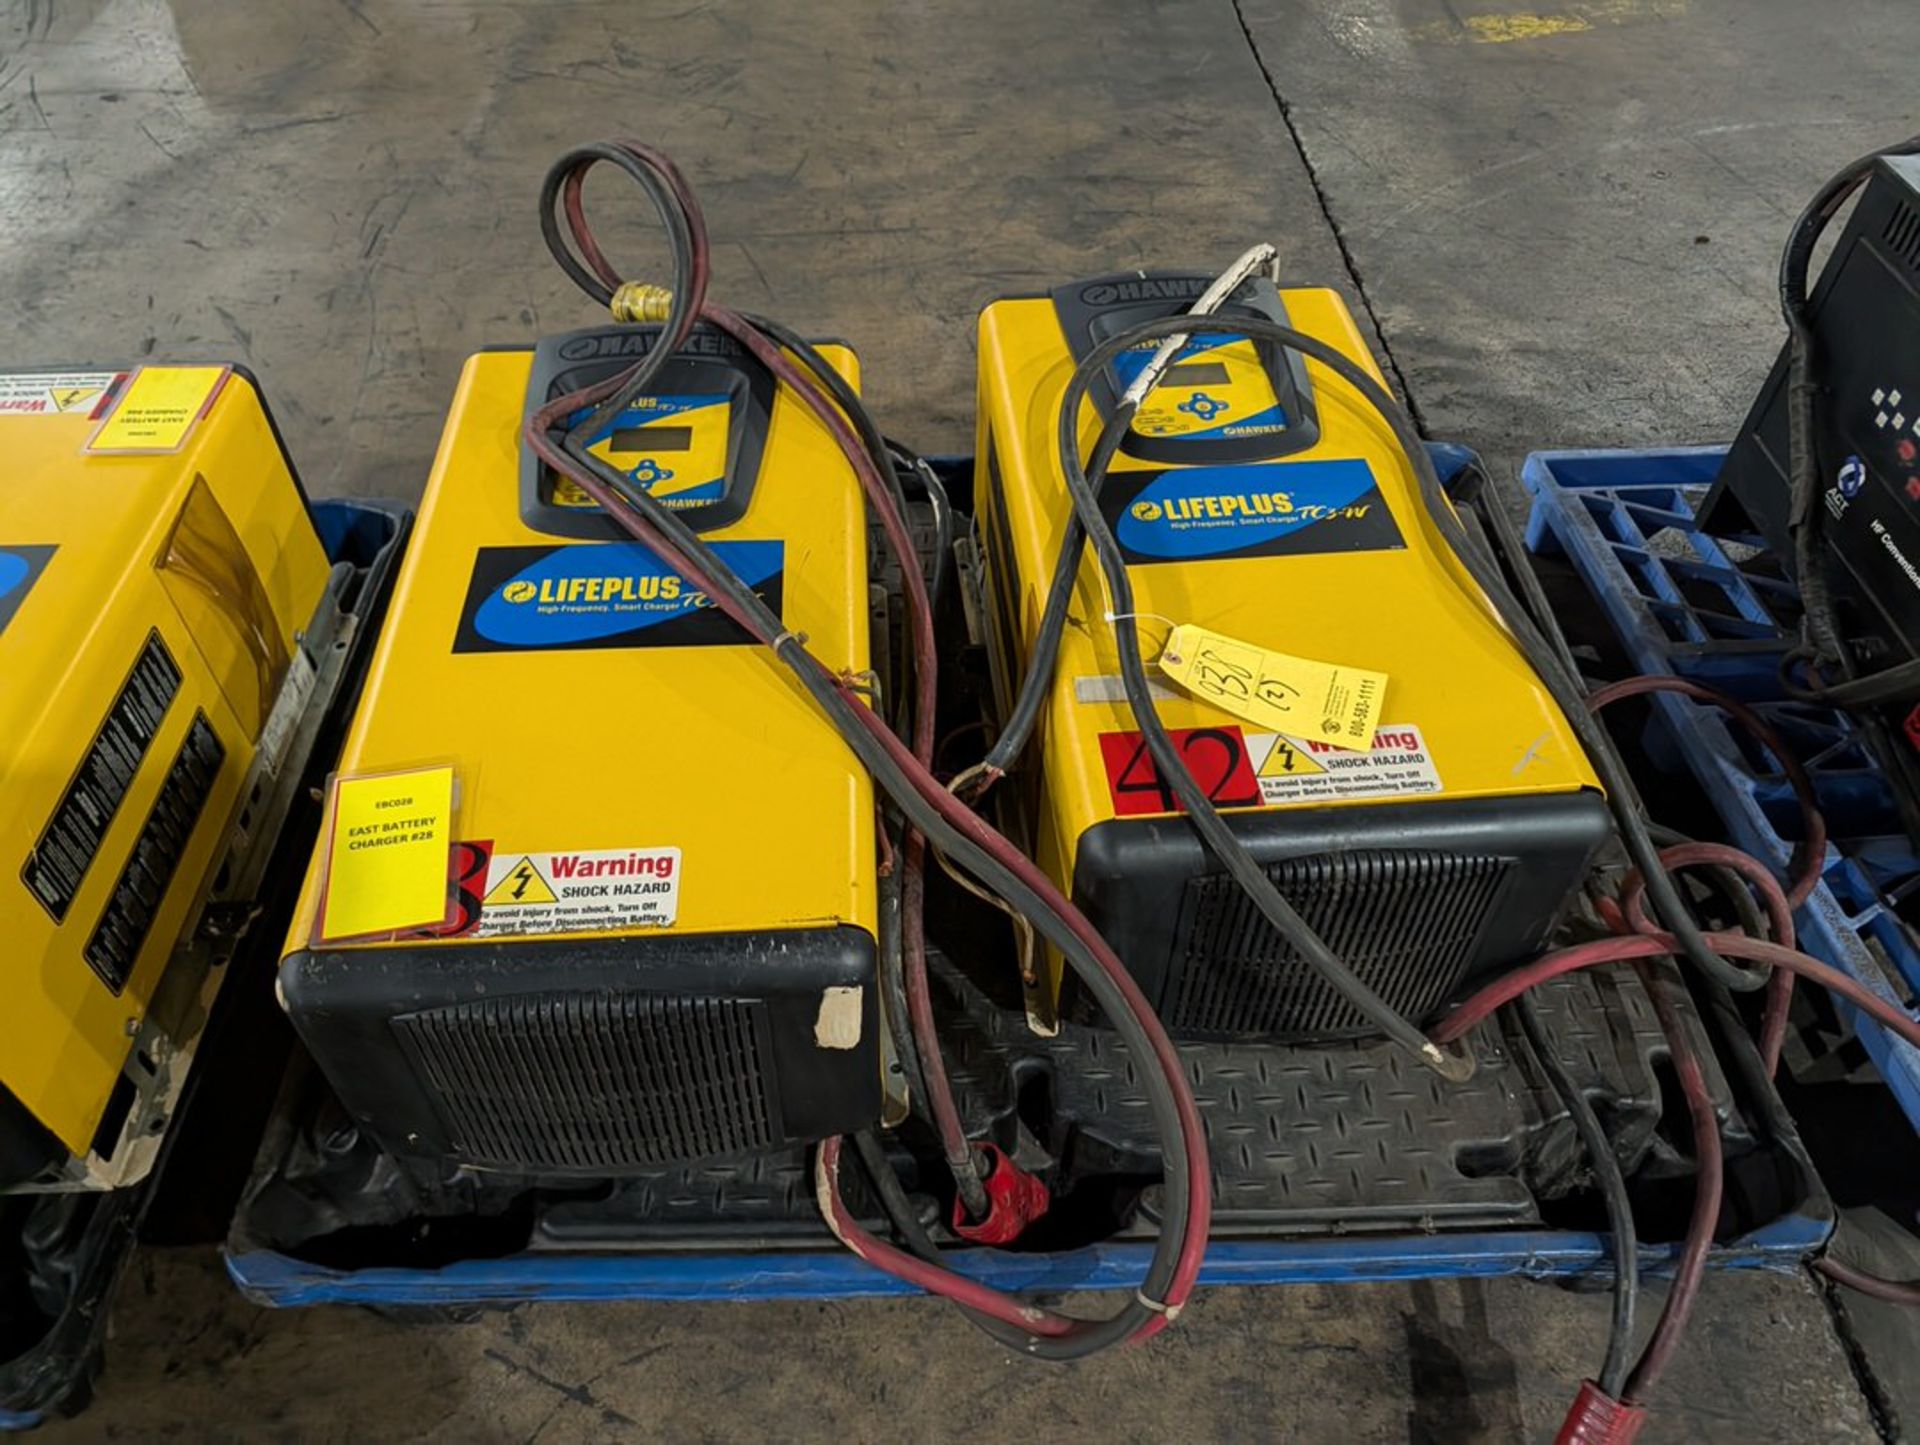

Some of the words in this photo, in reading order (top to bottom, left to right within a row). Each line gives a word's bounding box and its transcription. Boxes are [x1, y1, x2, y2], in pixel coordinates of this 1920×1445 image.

[0, 400, 46, 412] Warn
[1237, 424, 1286, 435] HAWKER
[1163, 492, 1294, 520] LIFEPLUS
[1827, 488, 1849, 511] ACT
[1171, 521, 1189, 530] High
[1240, 517, 1265, 526] Smart
[1266, 515, 1299, 526] Charger
[1870, 519, 1885, 533] HF
[1882, 534, 1920, 588] Convention
[538, 575, 681, 603] LIFEPLUS
[537, 604, 561, 614] High
[614, 602, 642, 612] Smart
[643, 602, 680, 612] Charger
[1306, 729, 1419, 752] Wing
[1328, 756, 1370, 769] SHOCK
[1372, 753, 1425, 766] HAZARD
[1117, 729, 1260, 812] 42
[1275, 779, 1299, 788] avoid
[1384, 772, 1405, 780] Turn
[1264, 790, 1300, 799] Charger
[1303, 788, 1333, 796] Before
[1335, 783, 1400, 793] Disconnecting
[350, 823, 379, 837] EAST
[382, 816, 437, 832] BATTERY
[349, 835, 409, 850] CHARGER
[411, 830, 434, 842] #28
[550, 852, 673, 879] Warning
[561, 884, 609, 899] SHOCK
[613, 881, 671, 896] HAZARD
[493, 907, 521, 918] avoid
[554, 906, 579, 914] from
[617, 902, 639, 912] Turn
[641, 901, 658, 911] Off
[519, 919, 552, 929] Before
[555, 915, 627, 927] Disconnecting
